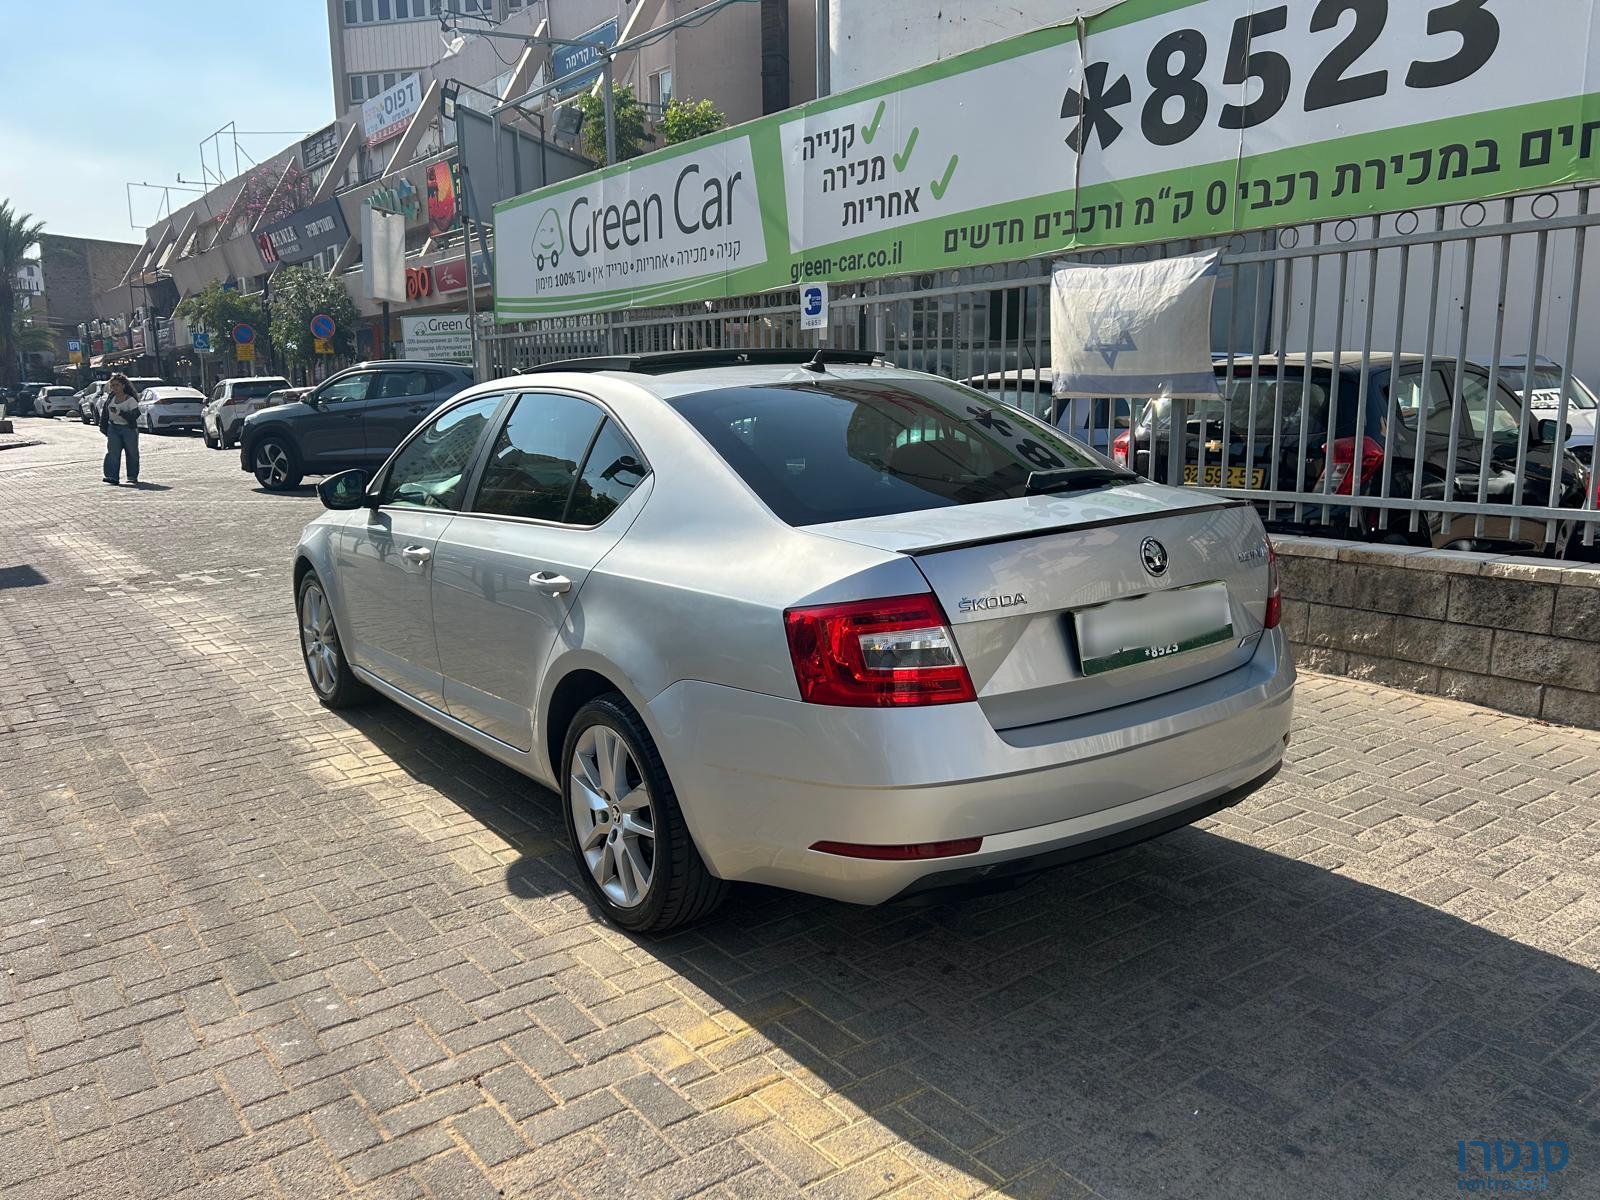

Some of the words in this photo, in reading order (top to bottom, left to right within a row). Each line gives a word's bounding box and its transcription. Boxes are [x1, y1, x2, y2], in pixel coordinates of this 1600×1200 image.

[384, 83, 413, 115] דפוס
[803, 124, 854, 160] קנייה
[823, 156, 885, 192] מכירה
[1331, 139, 1500, 197] במכירת
[1238, 170, 1319, 210] רכבי
[569, 196, 663, 257] Green
[674, 164, 741, 234] Car
[842, 187, 920, 226] אחריות
[1034, 202, 1123, 239] ורכבים
[717, 240, 741, 261] קניה
[944, 218, 1024, 252] חדשים
[606, 261, 629, 278] טרייד
[636, 253, 669, 273] אחריות
[677, 246, 707, 266] מכירה
[791, 241, 903, 283] green-car.co.il
[535, 276, 553, 295] מימון
[555, 271, 576, 287] 100%
[576, 269, 587, 283] עד
[428, 318, 463, 331] Green
[958, 593, 1028, 613] ŠKODA
